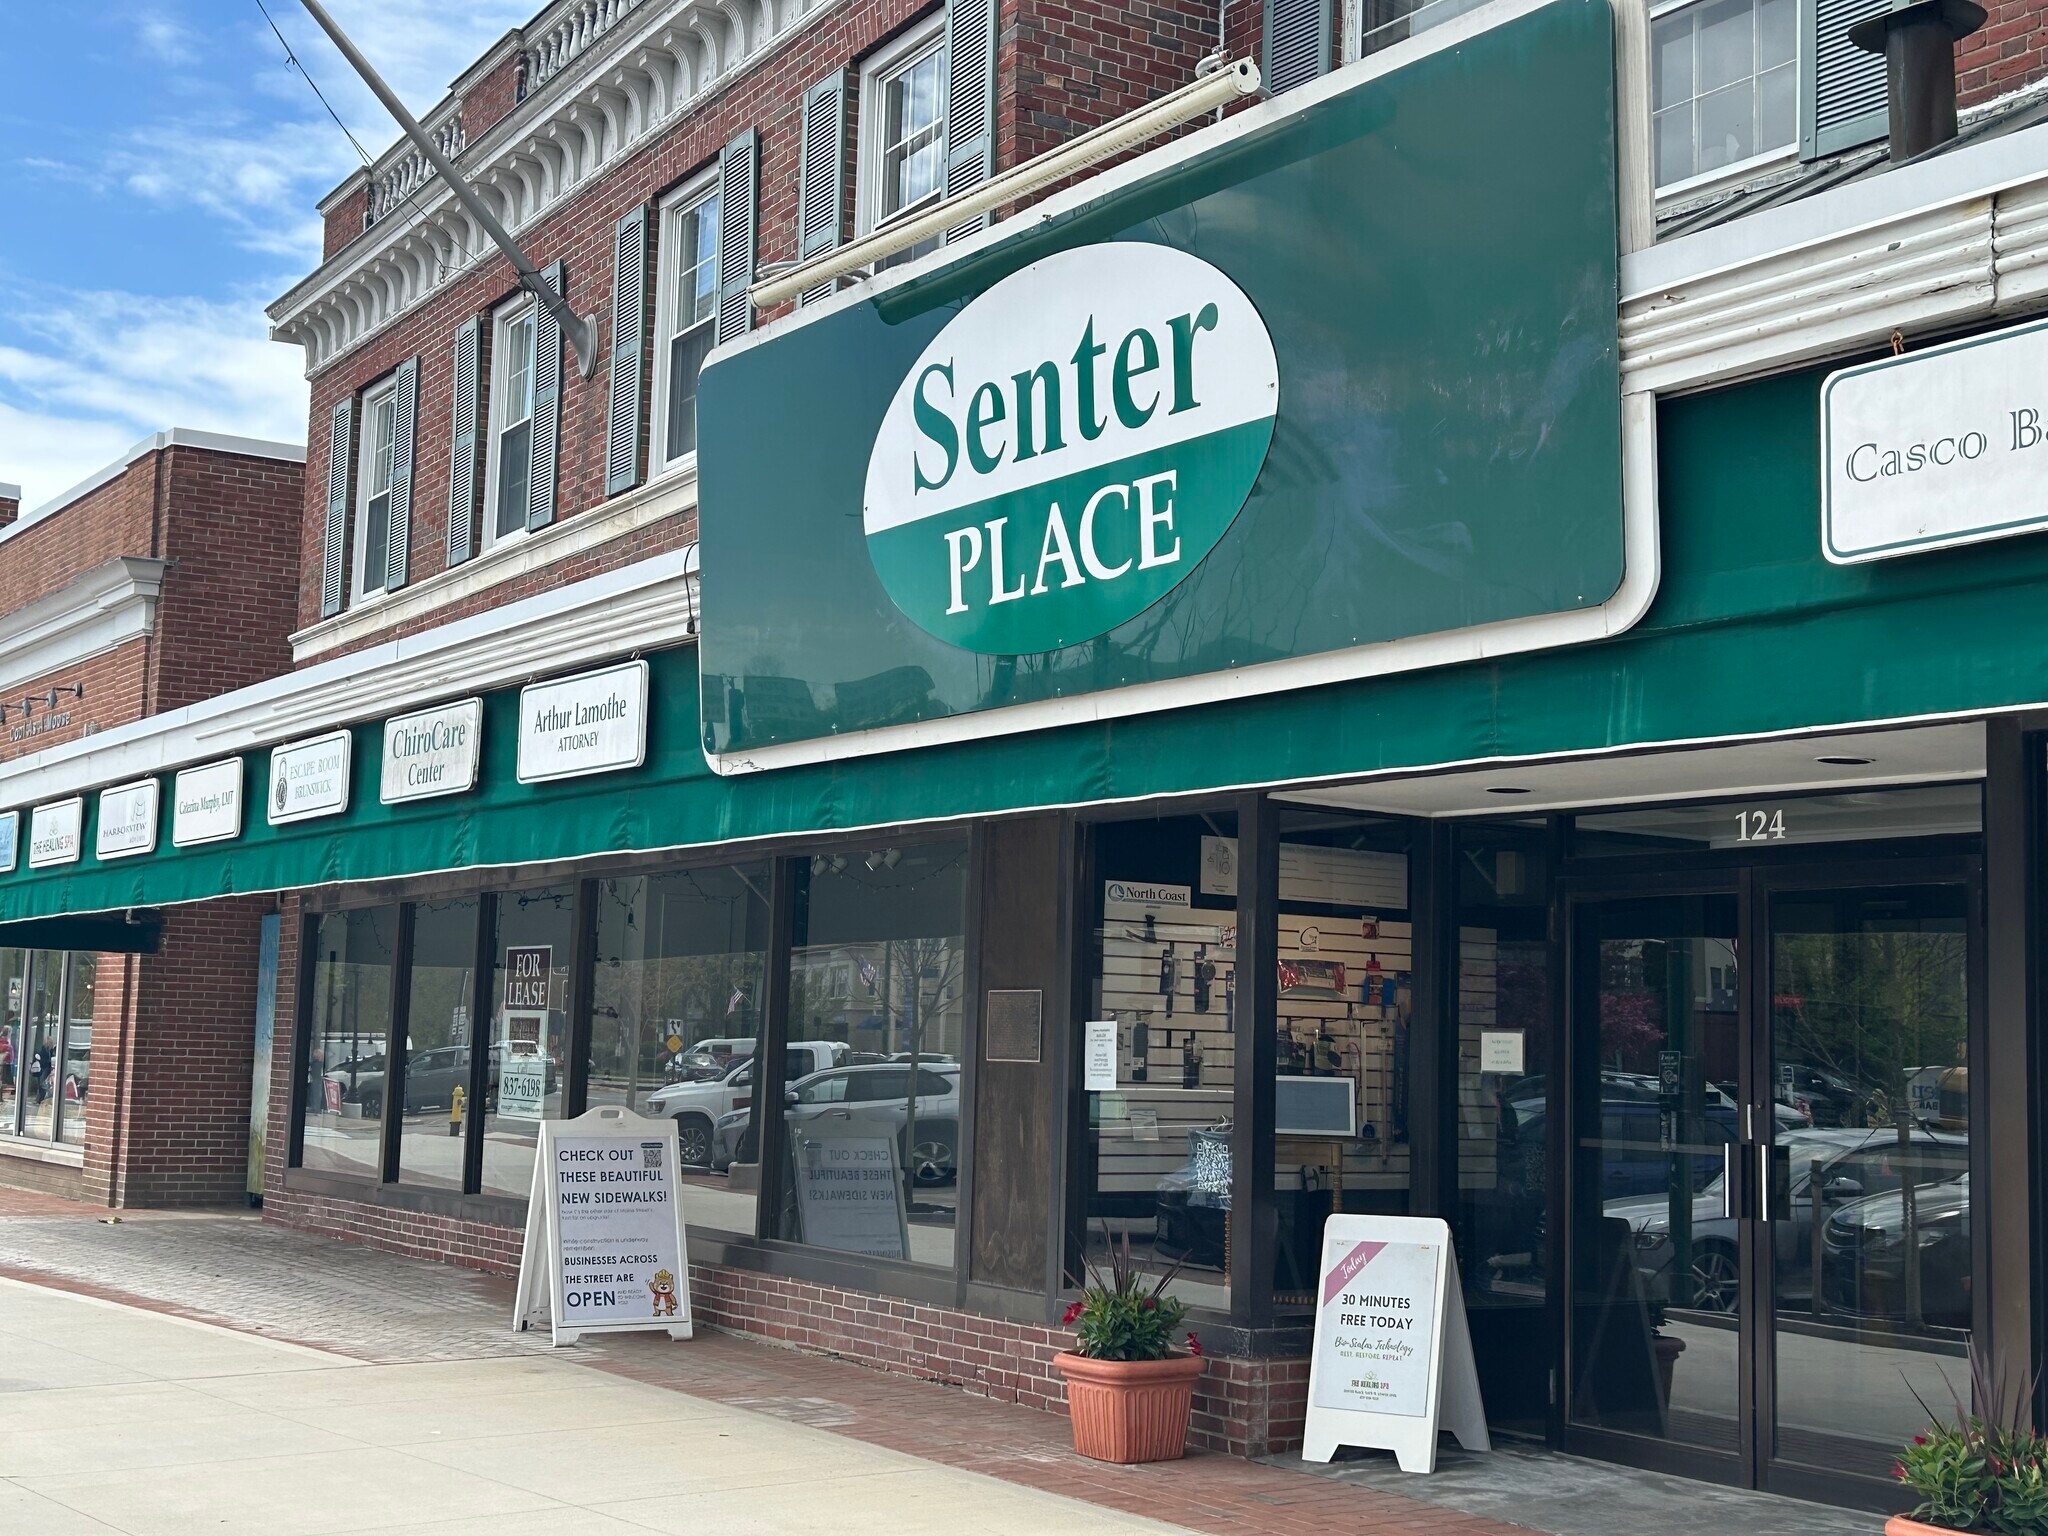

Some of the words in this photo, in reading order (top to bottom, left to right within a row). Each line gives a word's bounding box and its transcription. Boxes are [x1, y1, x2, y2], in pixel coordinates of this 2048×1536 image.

[912, 302, 1219, 496] Senter
[1846, 432, 1988, 482] Casco
[2009, 408, 2048, 451] B
[943, 469, 1181, 615] PLACE
[534, 708, 572, 734] Arthur
[575, 692, 627, 726] Lamothe
[393, 720, 466, 759] ChiroCare
[557, 731, 600, 752] ATTORNEY
[290, 763, 315, 781] ESCAPE
[317, 755, 341, 773] ROOM
[408, 763, 445, 786] Center
[221, 791, 234, 807] LMT
[294, 779, 332, 800] BRUNSWICK
[103, 822, 147, 838] HARBORVIEW
[1735, 809, 1786, 841] 124
[1126, 887, 1156, 899] North
[1158, 889, 1186, 901] Coast
[515, 953, 540, 977] FOR
[508, 981, 546, 1006] LEASE
[559, 1150, 604, 1161] CHECK
[608, 1150, 634, 1161] OUT
[560, 1171, 596, 1182] THESE
[600, 1170, 663, 1182] BEAUTIFUL
[561, 1192, 590, 1204] NEW
[594, 1191, 667, 1203] SIDEWALKS!
[564, 1256, 617, 1265] BUSINESSES
[620, 1255, 657, 1264] ACROSS
[1340, 1252, 1367, 1279] Today
[565, 1275, 581, 1284] THE
[584, 1274, 613, 1283] STREET
[616, 1274, 634, 1282] ARE
[567, 1291, 615, 1307] OPEN
[1342, 1294, 1355, 1305] 30
[1360, 1295, 1410, 1309] MINUTES
[1340, 1314, 1366, 1326] FREE
[1370, 1316, 1413, 1329] TODAY
